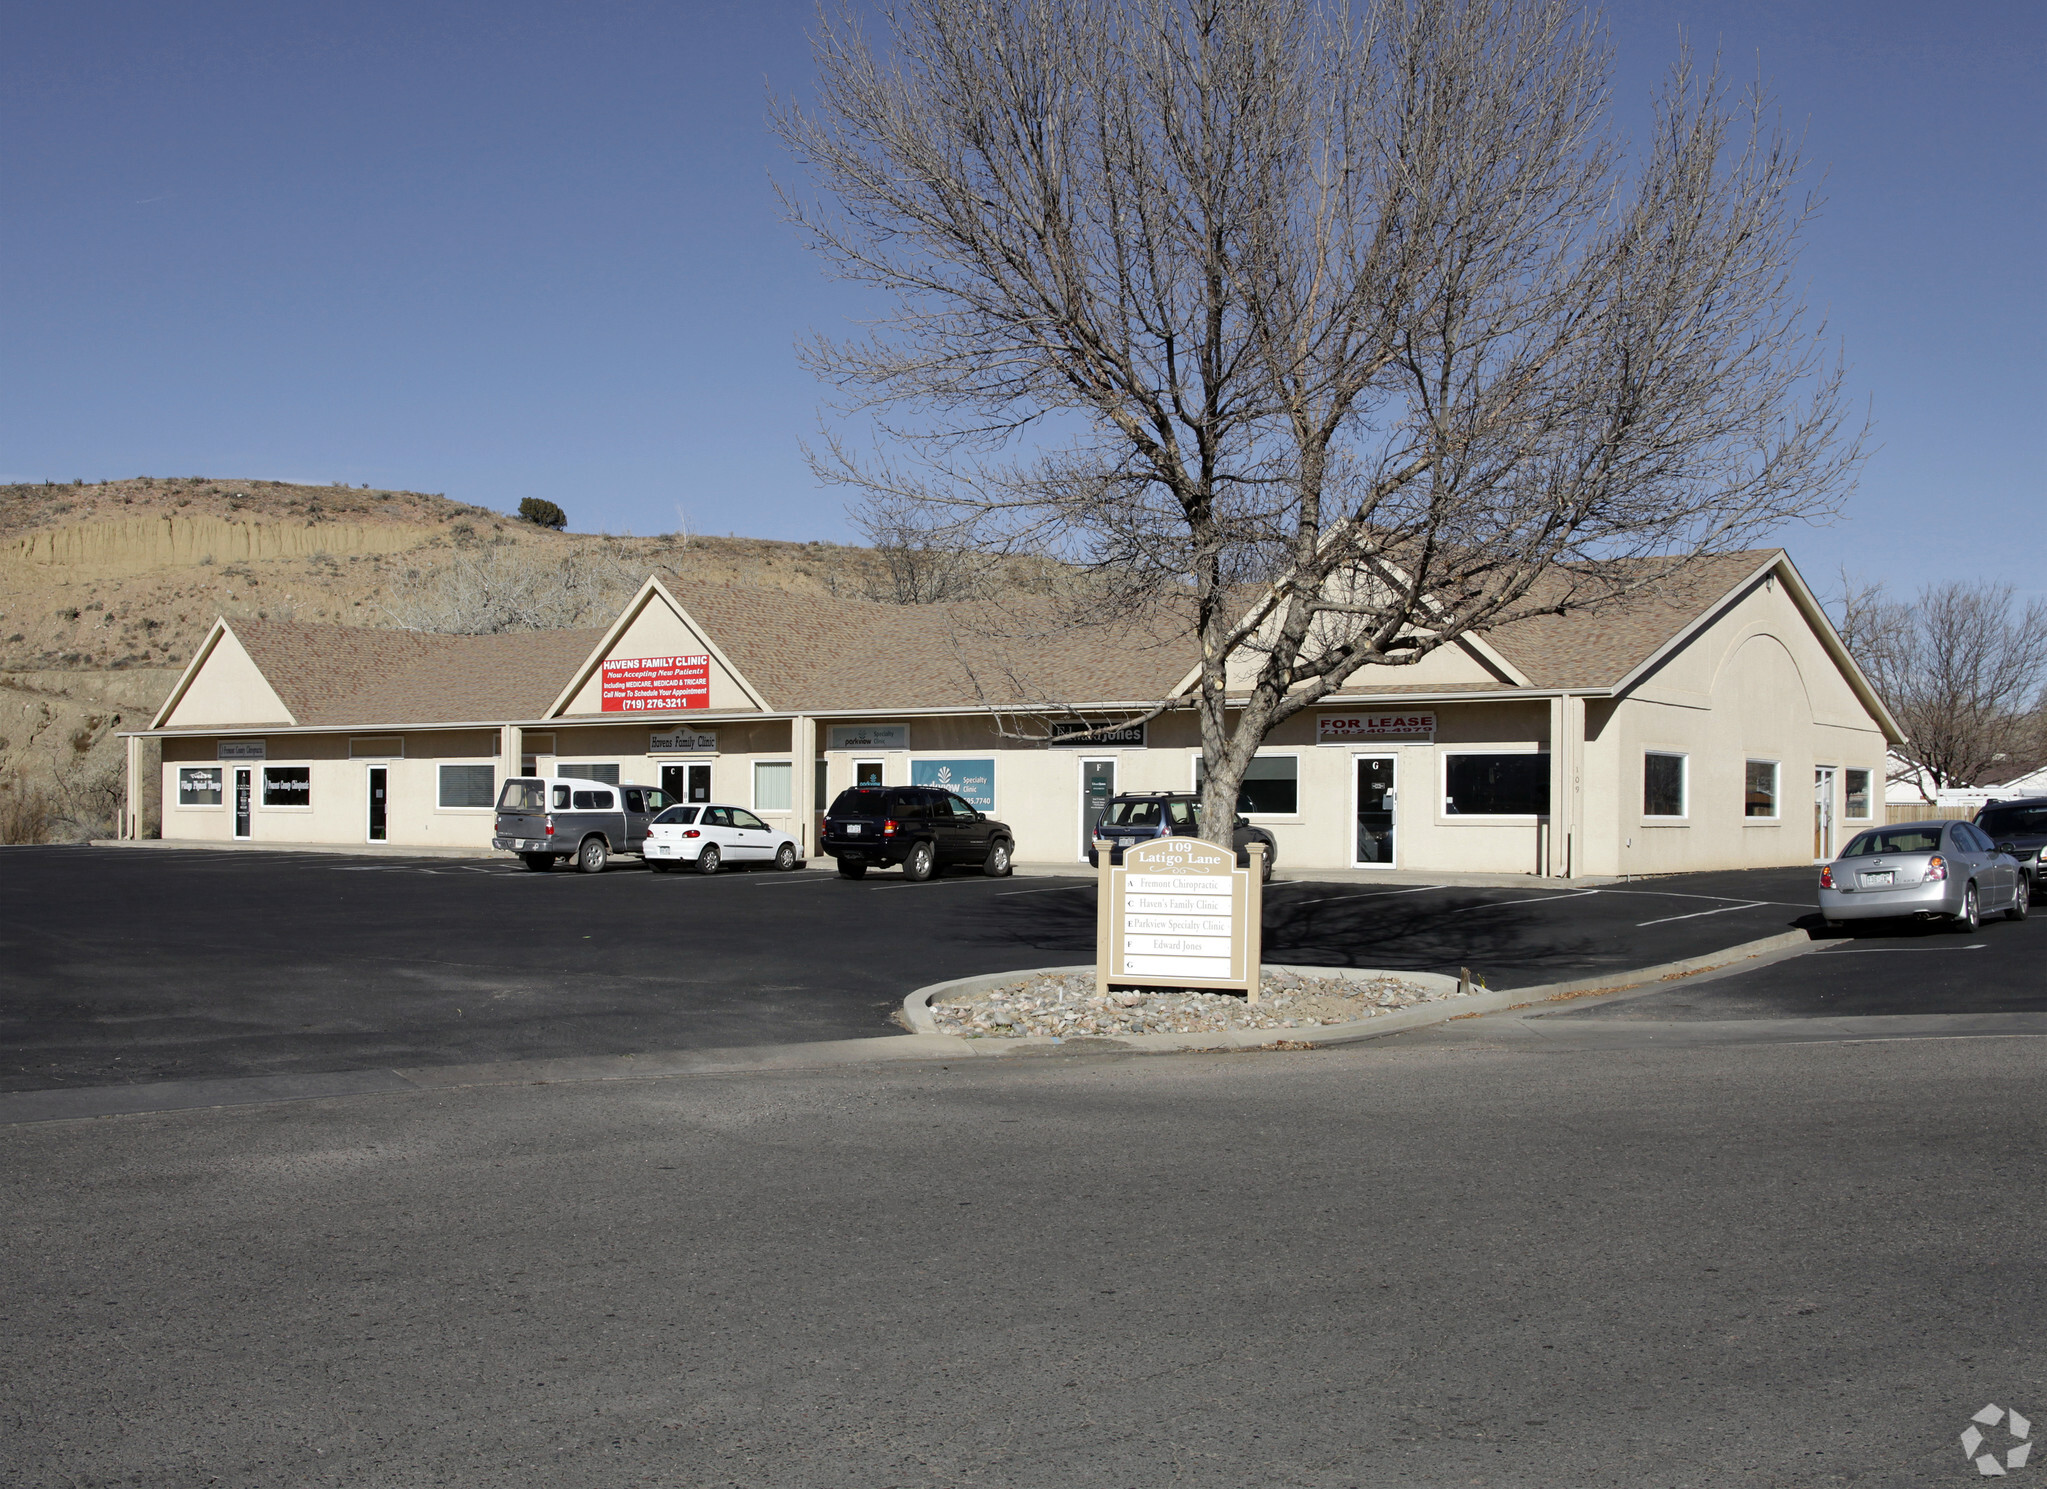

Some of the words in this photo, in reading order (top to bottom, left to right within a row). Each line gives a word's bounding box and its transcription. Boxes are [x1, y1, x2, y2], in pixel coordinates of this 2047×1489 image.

[603, 660, 640, 670] HAVENS
[642, 658, 674, 668] FAMILY
[676, 656, 707, 666] CLINIC
[623, 670, 657, 678] Accepting
[653, 679, 678, 687] MEDICAID
[672, 687, 707, 696] Appointment
[623, 699, 645, 710] (719)
[647, 698, 687, 708] 276-3211
[1321, 719, 1360, 728] FOR
[1368, 717, 1432, 727] LEASE
[1321, 727, 1432, 735] 719-240-4979
[652, 736, 672, 748] Havens
[675, 736, 695, 750] Family
[698, 736, 715, 747] Clinic
[1372, 761, 1379, 770] G
[963, 776, 987, 785] Specialty
[1168, 842, 1192, 852] 109
[1139, 852, 1182, 866] Latigo
[1188, 853, 1221, 864] Lane
[1140, 878, 1171, 888] Fremont
[1173, 879, 1218, 892] Chiropractic
[1139, 899, 1168, 908] Haven's
[1169, 899, 1194, 911] Family
[1196, 900, 1218, 910] Clinic
[1134, 918, 1166, 928] Parkview
[1168, 920, 1200, 932] Specialty
[1202, 921, 1224, 931] Clinic
[1153, 940, 1180, 950] Edward
[1182, 941, 1202, 951] Jones
